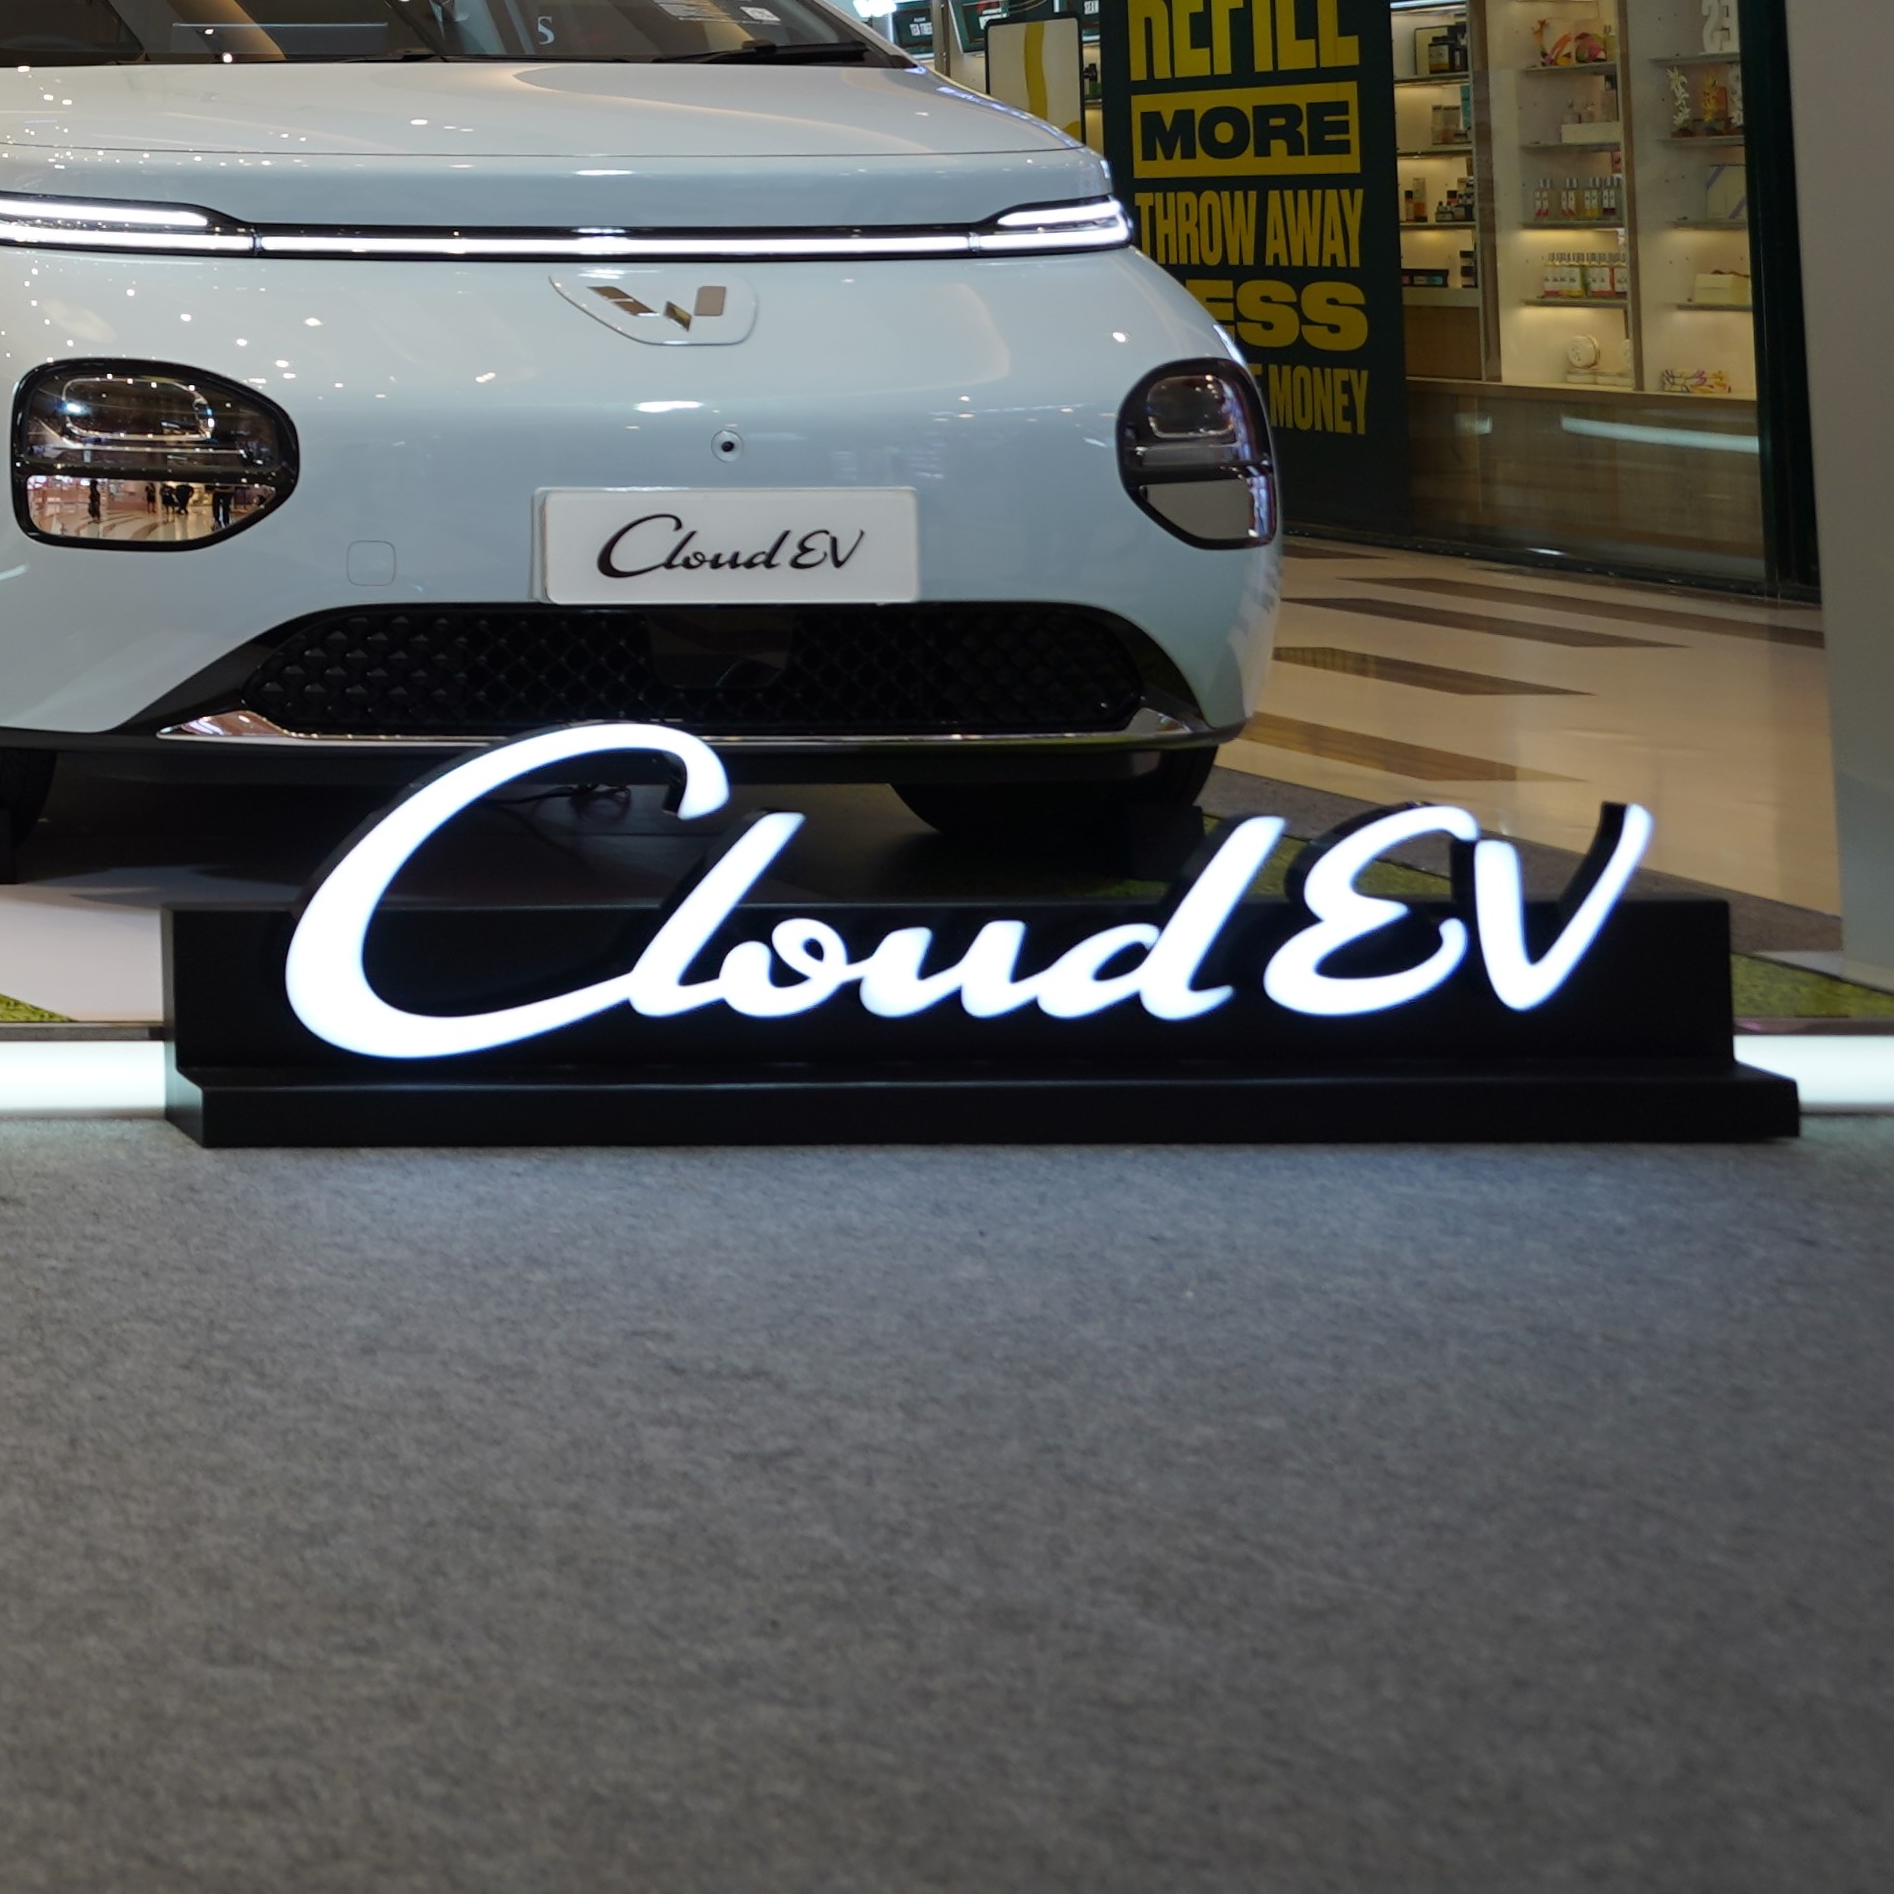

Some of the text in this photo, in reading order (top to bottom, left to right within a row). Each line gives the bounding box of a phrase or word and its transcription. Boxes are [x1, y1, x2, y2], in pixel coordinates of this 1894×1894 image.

[1140, 100, 1352, 162] MORE
[1134, 189, 1364, 268] THROW AWAY
[1185, 279, 1369, 352] ESS
[1269, 363, 1369, 436] MONEY
[597, 513, 865, 578] Cloud EV
[284, 721, 1653, 1061] Cloud EV
